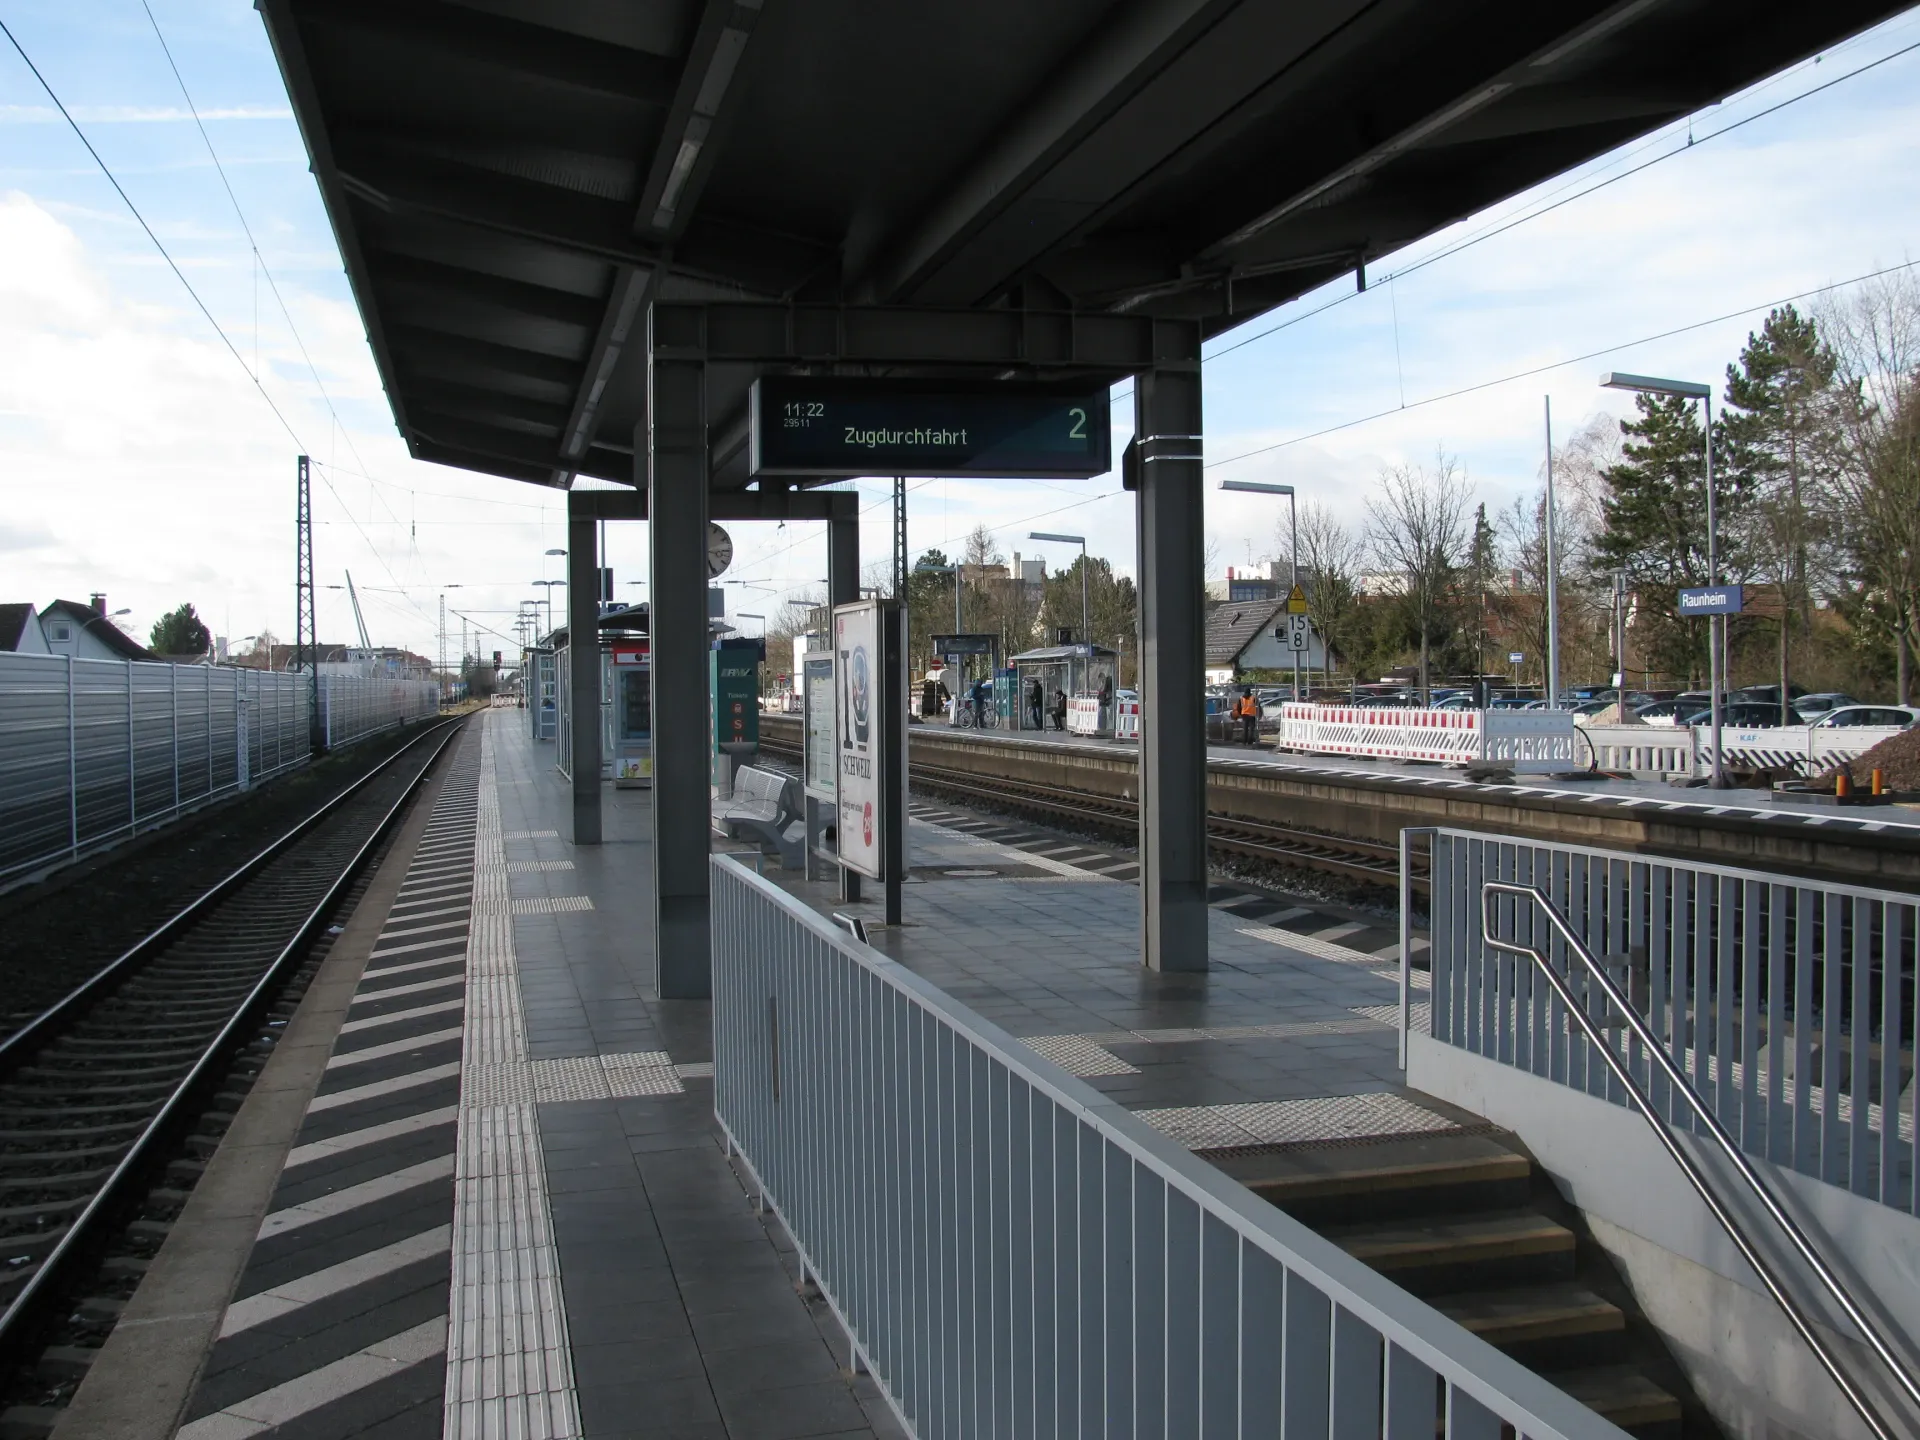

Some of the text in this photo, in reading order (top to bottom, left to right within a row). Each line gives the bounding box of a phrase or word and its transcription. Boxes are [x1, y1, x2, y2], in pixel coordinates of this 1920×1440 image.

[784, 403, 824, 417] 11:22
[1069, 408, 1087, 439] 2
[844, 427, 967, 448] Zugdurchfahrt
[1682, 592, 1727, 607] Raunheim
[1289, 615, 1306, 631] 15
[1293, 632, 1303, 648] 8
[844, 754, 871, 780] SCHWEIZ
